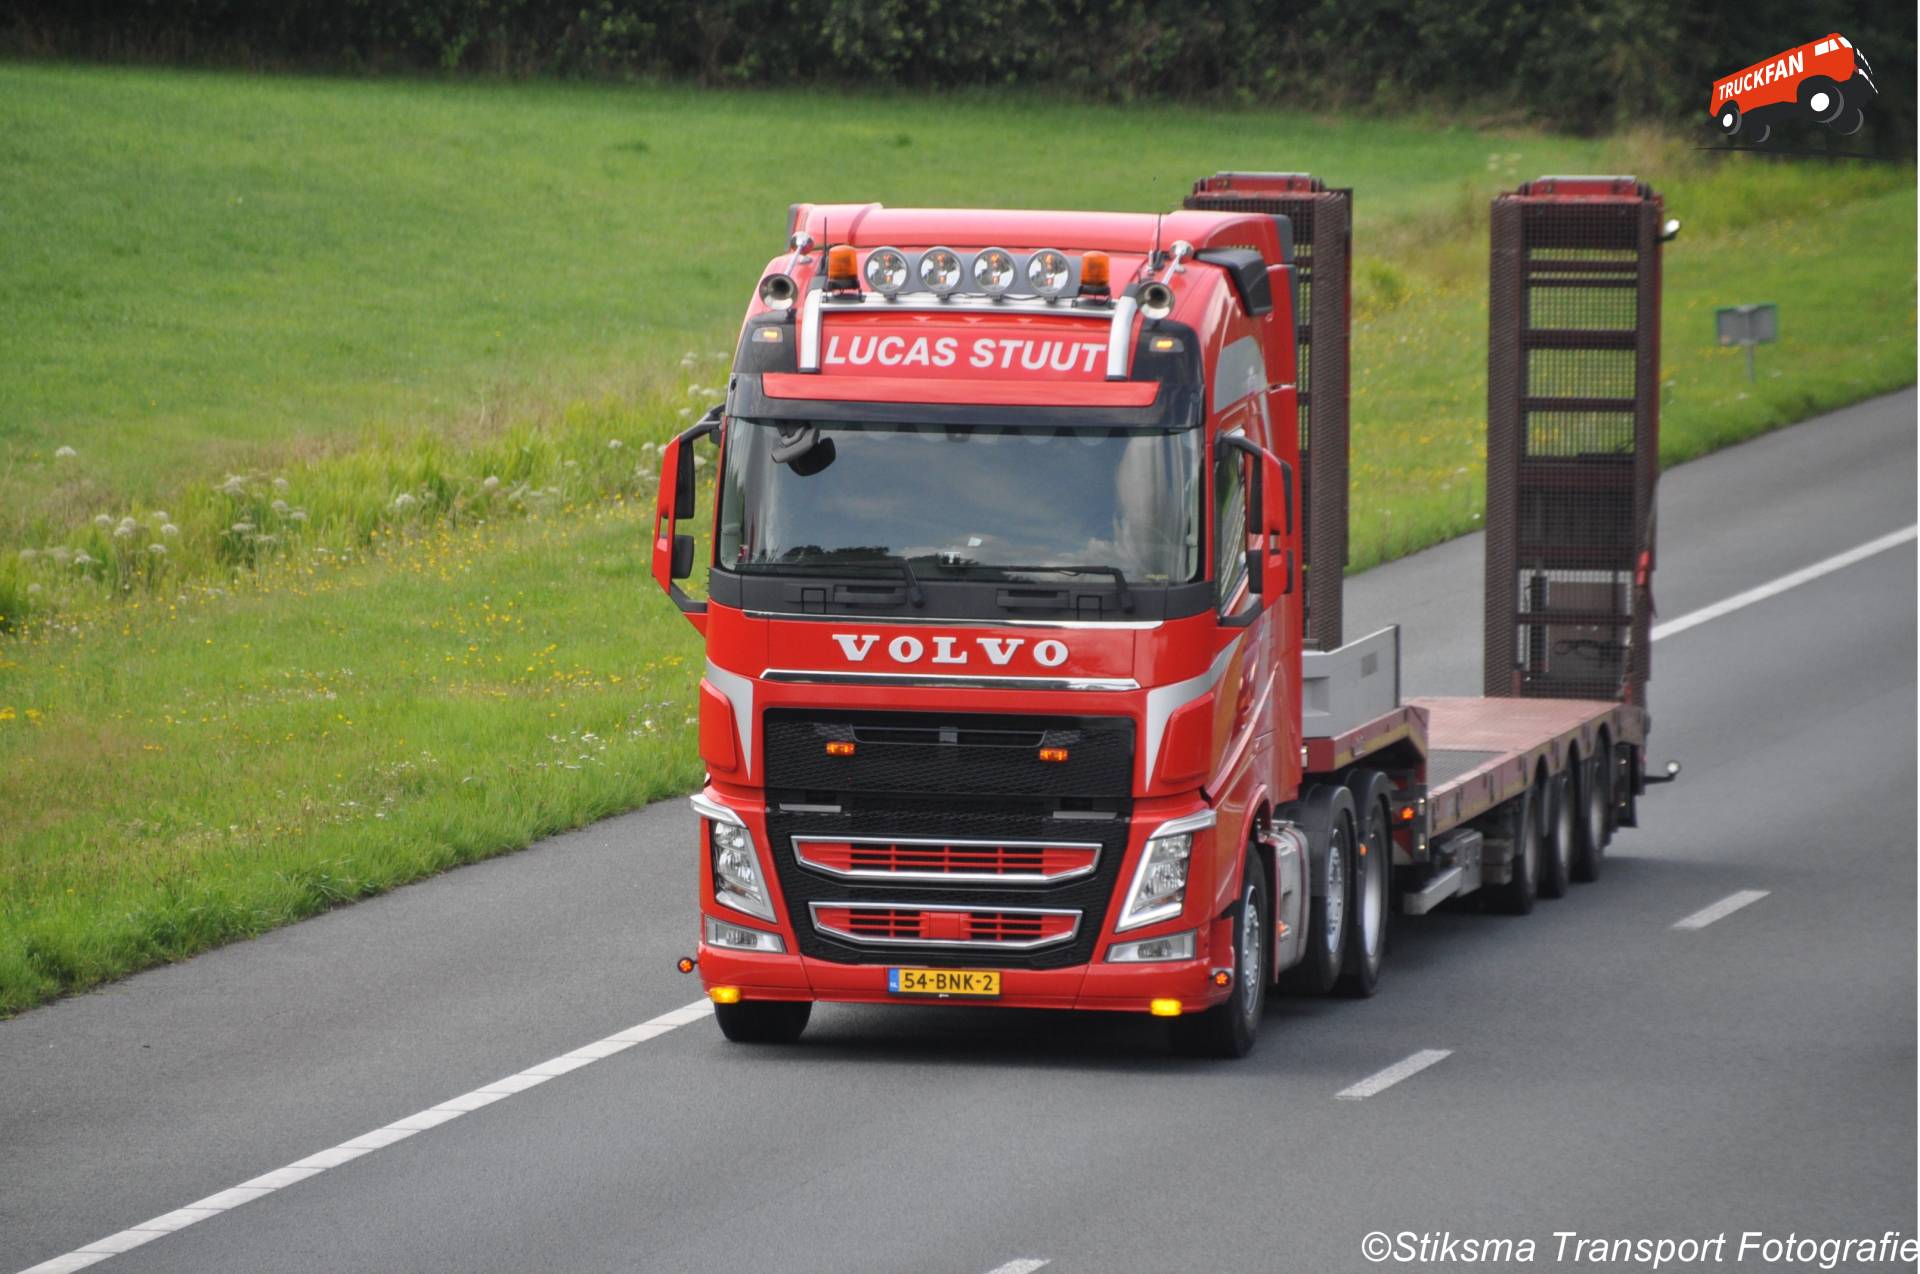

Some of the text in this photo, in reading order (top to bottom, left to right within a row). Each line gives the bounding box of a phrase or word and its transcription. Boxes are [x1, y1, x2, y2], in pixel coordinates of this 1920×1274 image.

[825, 335, 1107, 373] LUCAS STUUT
[832, 634, 1069, 667] VOLVO
[904, 972, 993, 991] 54-BNK-2
